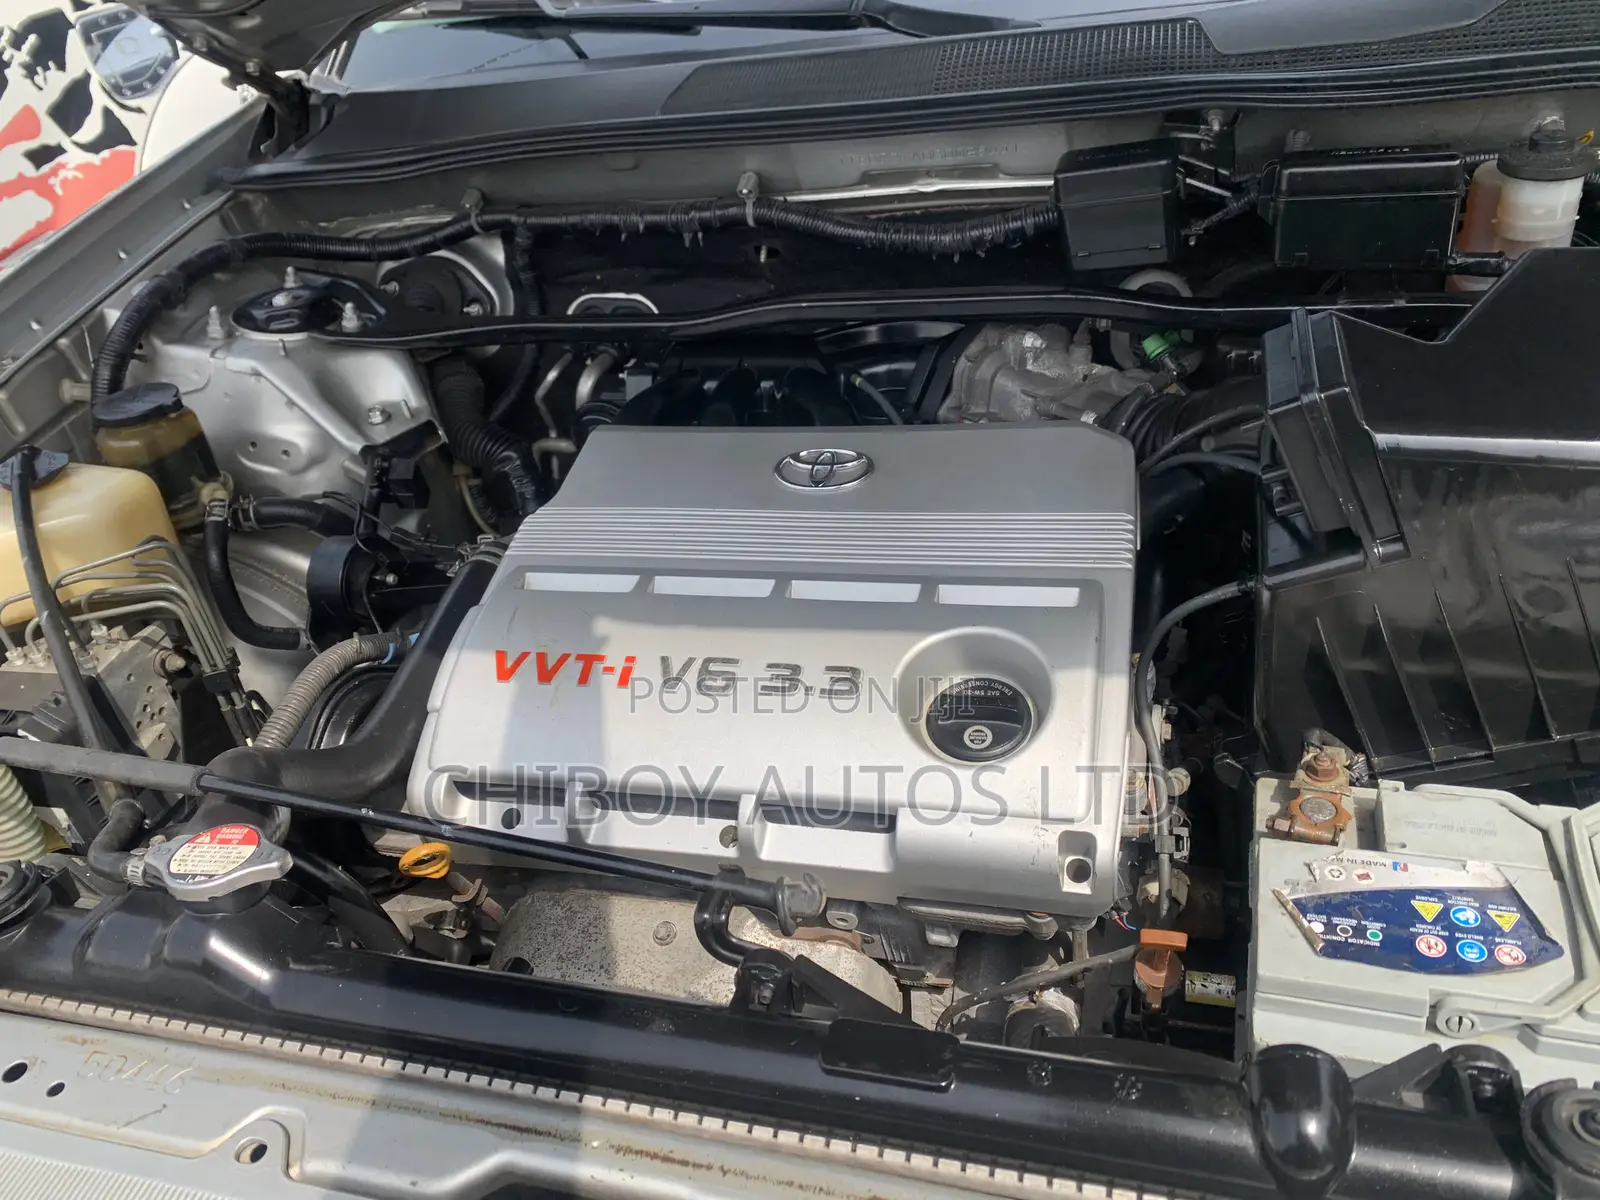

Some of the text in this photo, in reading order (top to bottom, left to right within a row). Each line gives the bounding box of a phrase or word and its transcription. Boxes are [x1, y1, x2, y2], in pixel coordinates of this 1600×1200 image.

[495, 650, 866, 699] VVT-i V6 3.3
[991, 681, 1013, 696] ENERGY
[1360, 860, 1387, 868] MADE
[1348, 938, 1381, 947] INDICATOR
